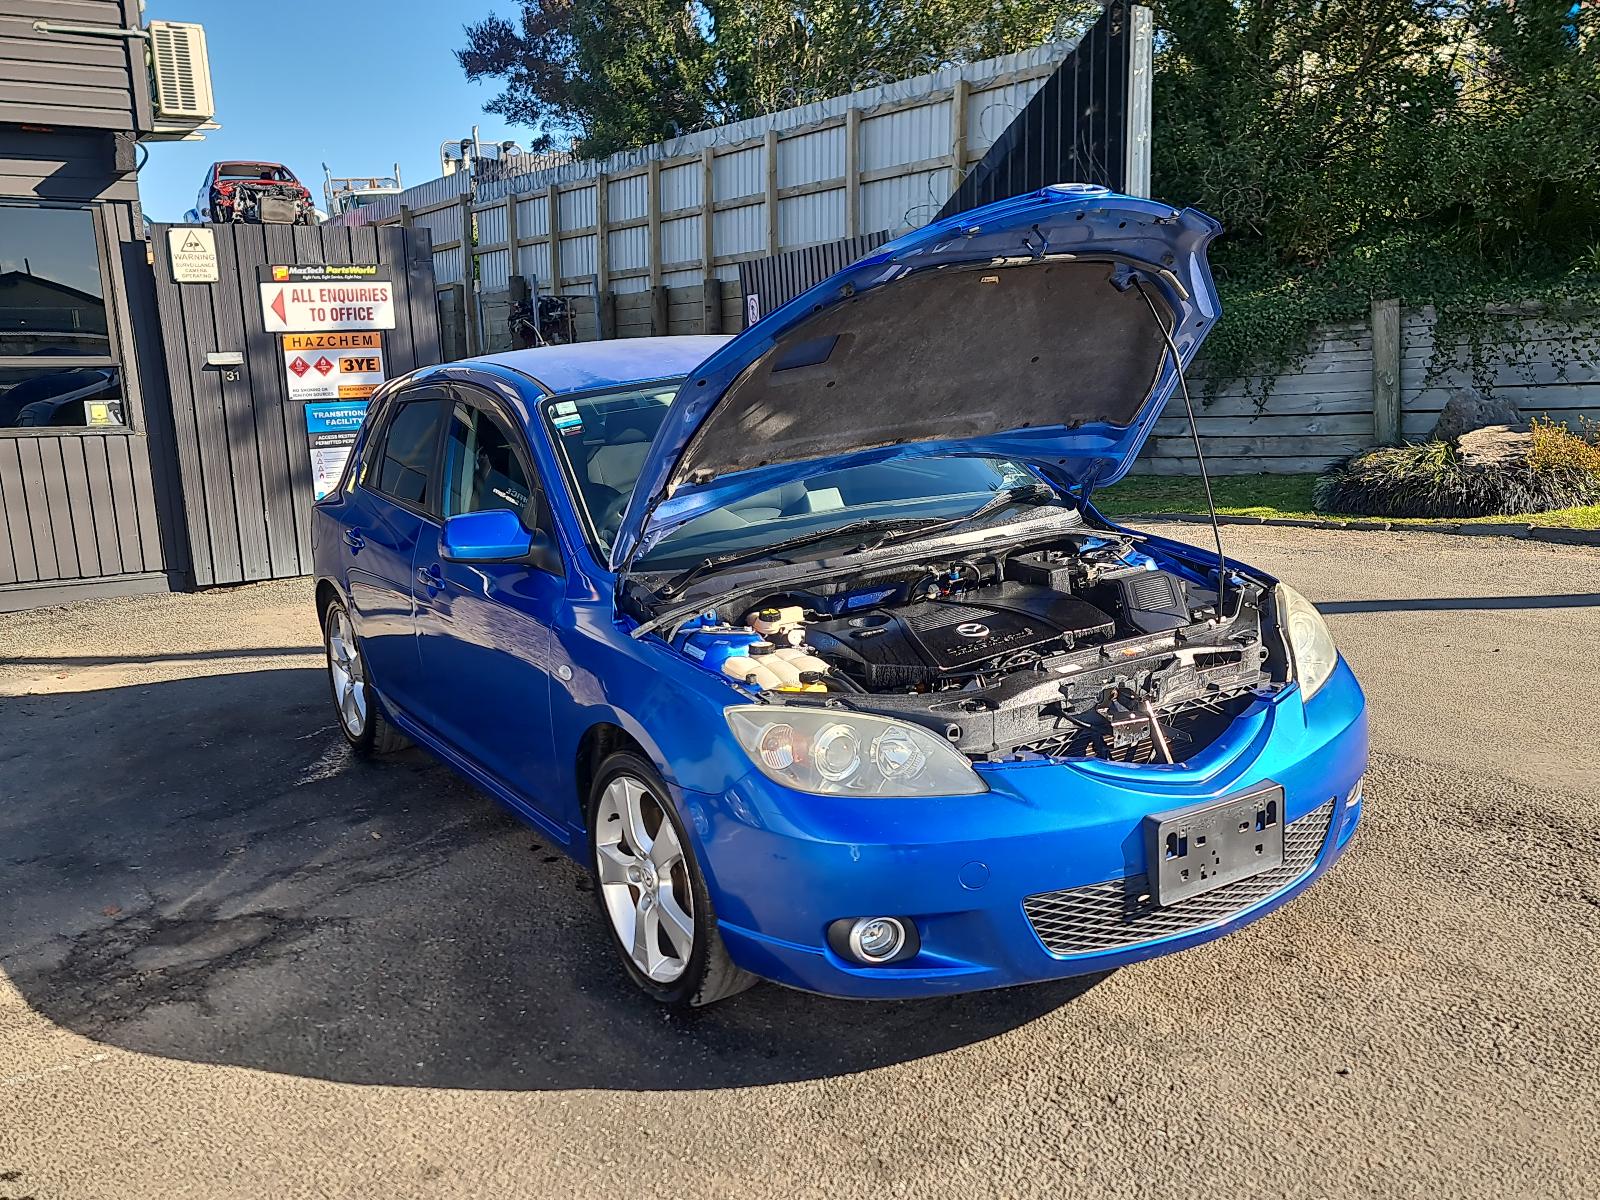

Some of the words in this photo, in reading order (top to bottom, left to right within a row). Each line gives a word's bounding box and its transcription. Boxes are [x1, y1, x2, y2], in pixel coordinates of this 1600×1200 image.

[173, 253, 215, 261] WARNING
[325, 265, 377, 275] PartsWorld
[291, 288, 316, 303] ALL
[319, 287, 388, 304] ENQUIRIES
[309, 307, 326, 322] TO
[330, 306, 375, 322] OFFICE
[292, 335, 373, 348] HAZCHEM
[344, 358, 377, 372] 3YE
[226, 370, 240, 382] 31
